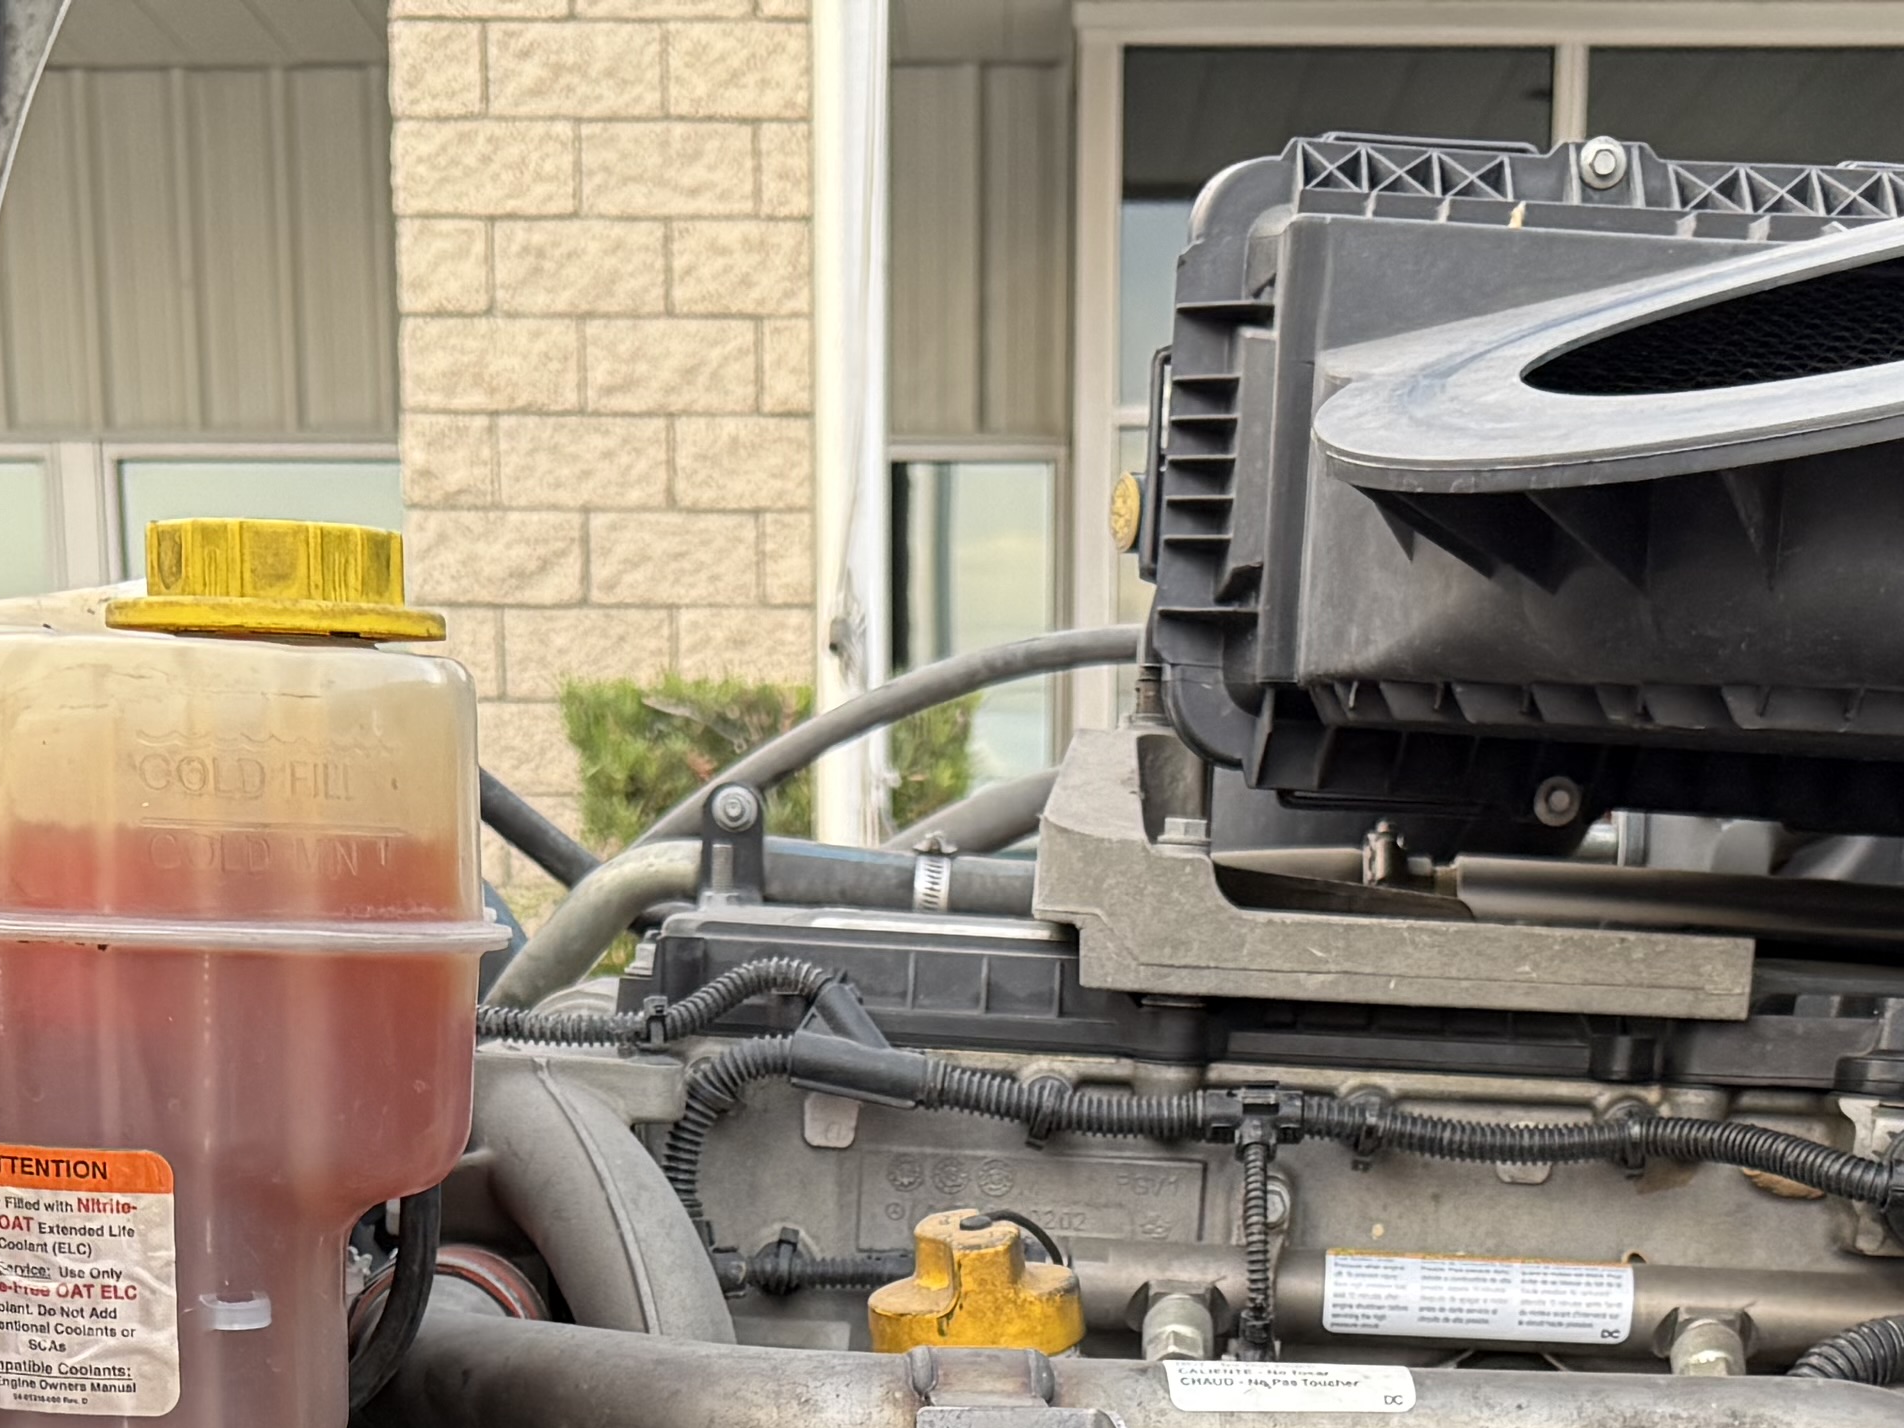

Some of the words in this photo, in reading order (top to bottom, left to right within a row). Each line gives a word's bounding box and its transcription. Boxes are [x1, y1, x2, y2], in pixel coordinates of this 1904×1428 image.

[138, 753, 266, 800] COLD
[4, 1196, 40, 1211] Filled
[43, 1199, 73, 1213] with
[77, 1197, 137, 1214] Nitrite-
[38, 1221, 105, 1237] Extended
[108, 1222, 135, 1238] Life
[52, 1240, 92, 1258] (ELC)
[58, 1266, 86, 1279] Use
[89, 1268, 123, 1282] Only
[56, 1283, 95, 1299] OAT
[100, 1285, 137, 1301] ELC
[37, 1304, 57, 1317] Do
[60, 1305, 85, 1319] Not
[89, 1307, 118, 1319] Add
[54, 1324, 117, 1337] Coolants
[120, 1327, 137, 1338] or
[1600, 1328, 1620, 1338] DC
[58, 1362, 132, 1377] Coolants:
[39, 1379, 87, 1392] Owners
[90, 1382, 137, 1393] Manual
[1180, 1377, 1234, 1387] CHAUD
[1302, 1379, 1360, 1388] Toucher
[1383, 1394, 1404, 1406] DC
